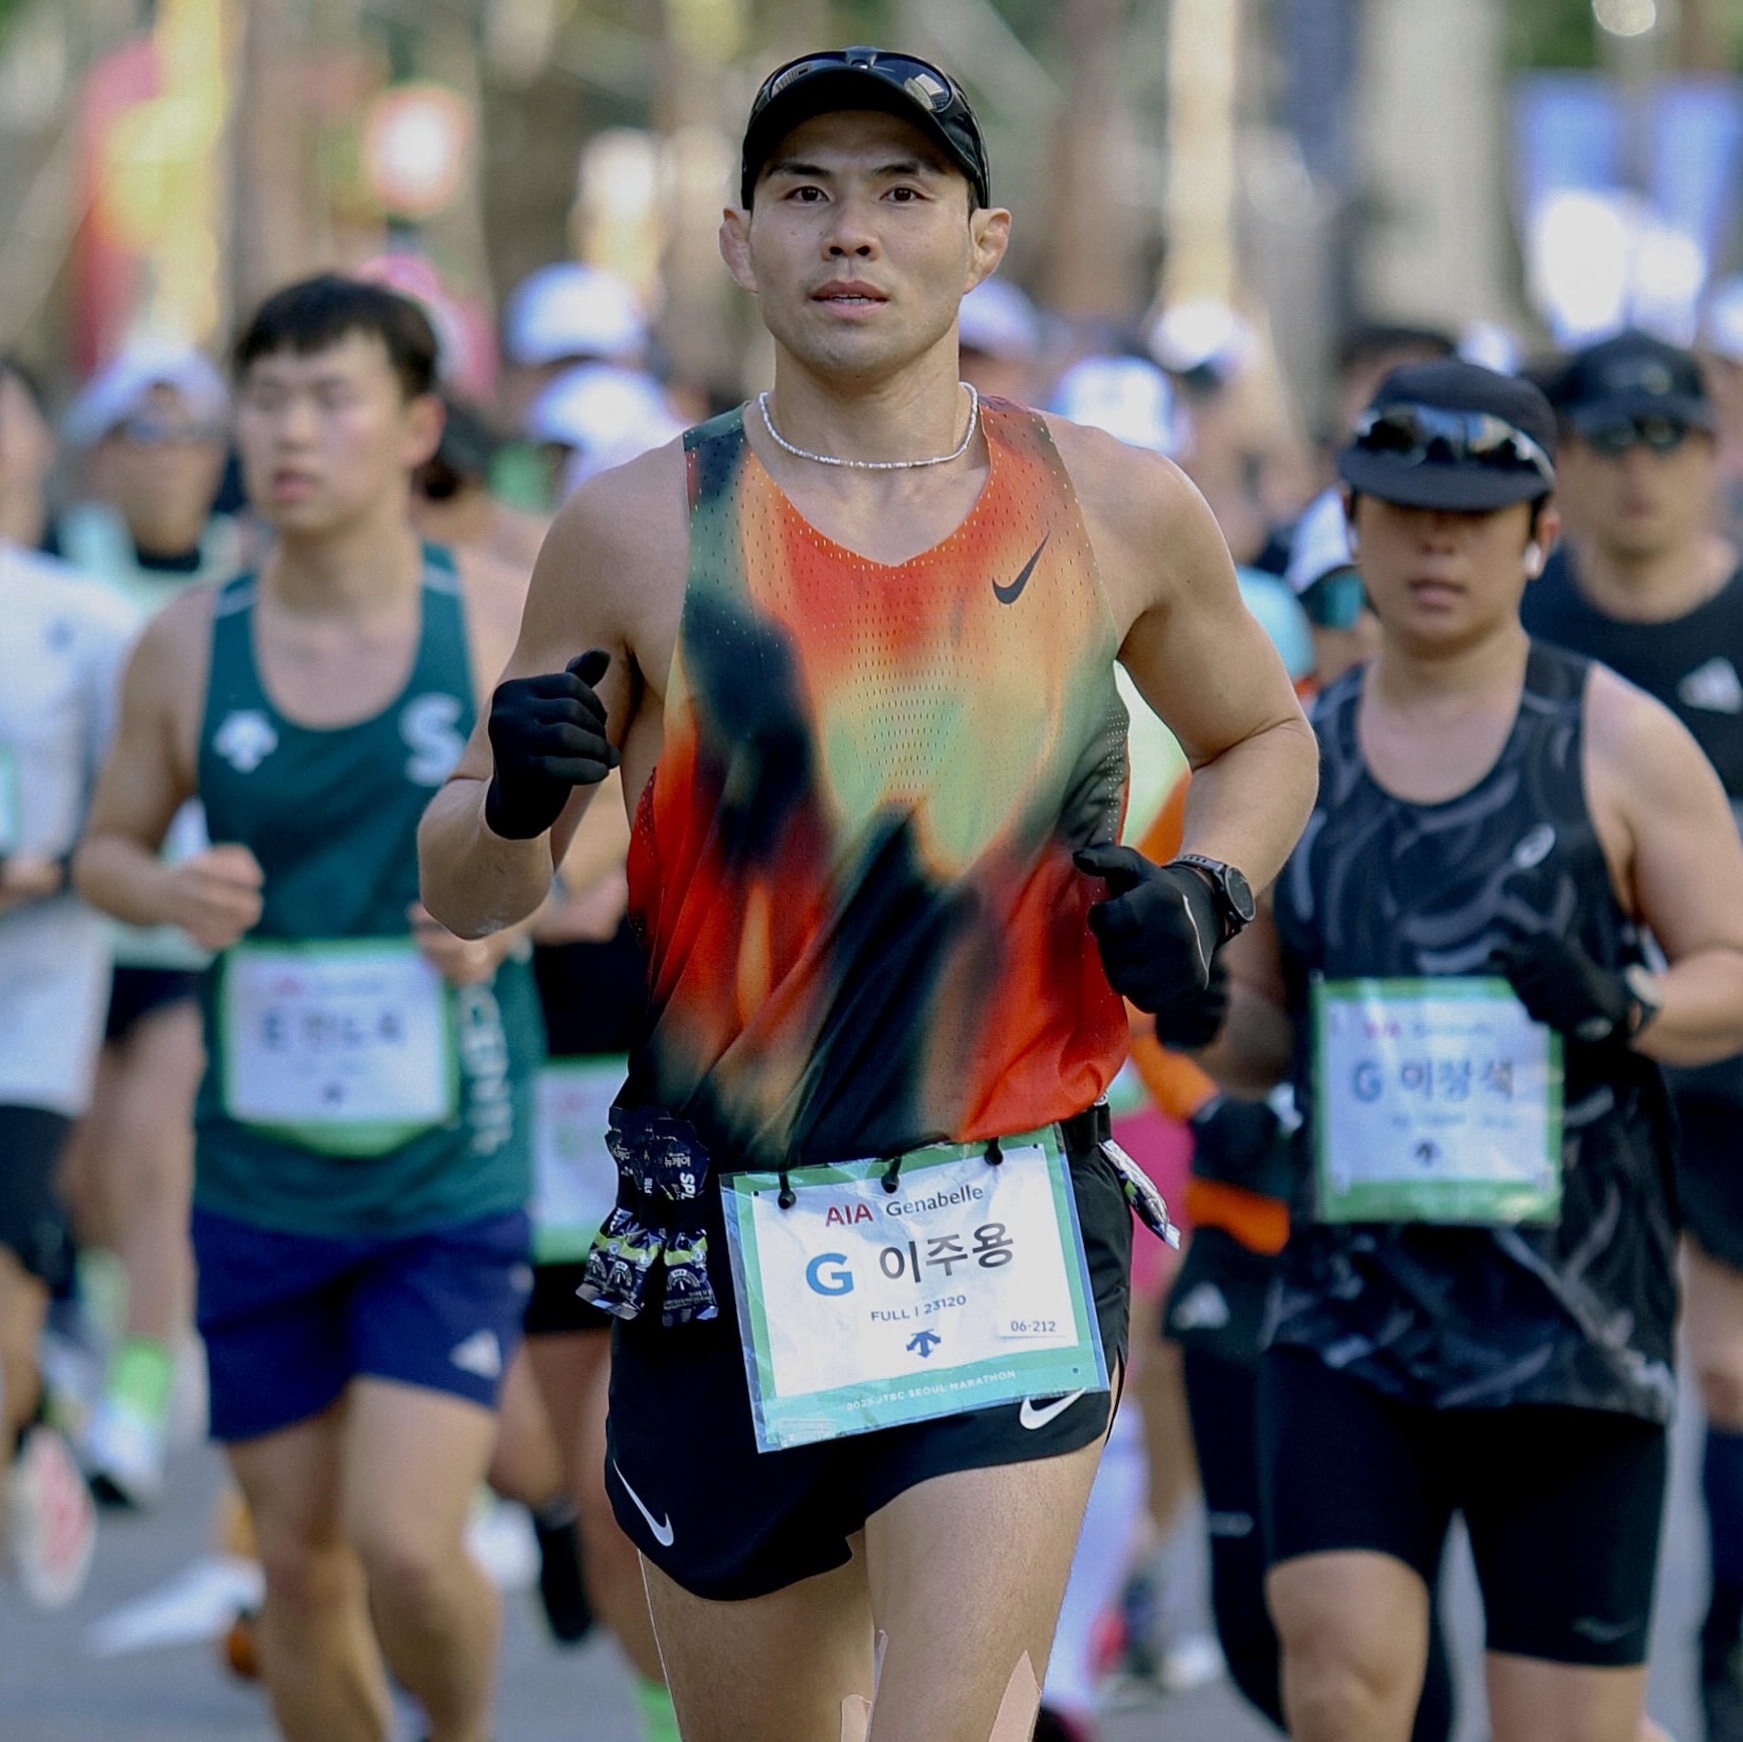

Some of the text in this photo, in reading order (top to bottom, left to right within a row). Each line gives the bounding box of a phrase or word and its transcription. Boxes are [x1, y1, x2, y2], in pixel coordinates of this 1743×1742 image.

[1353, 1058, 1382, 1104] G
[824, 1185, 984, 1228] AIA Genabelle
[805, 1222, 1015, 1297] G 이주용
[871, 1309, 911, 1322] FULL
[924, 1294, 967, 1315] 23120
[1010, 1320, 1057, 1333] 06-212
[908, 1384, 947, 1399] SEOUL
[950, 1369, 1017, 1392] MARATHON
